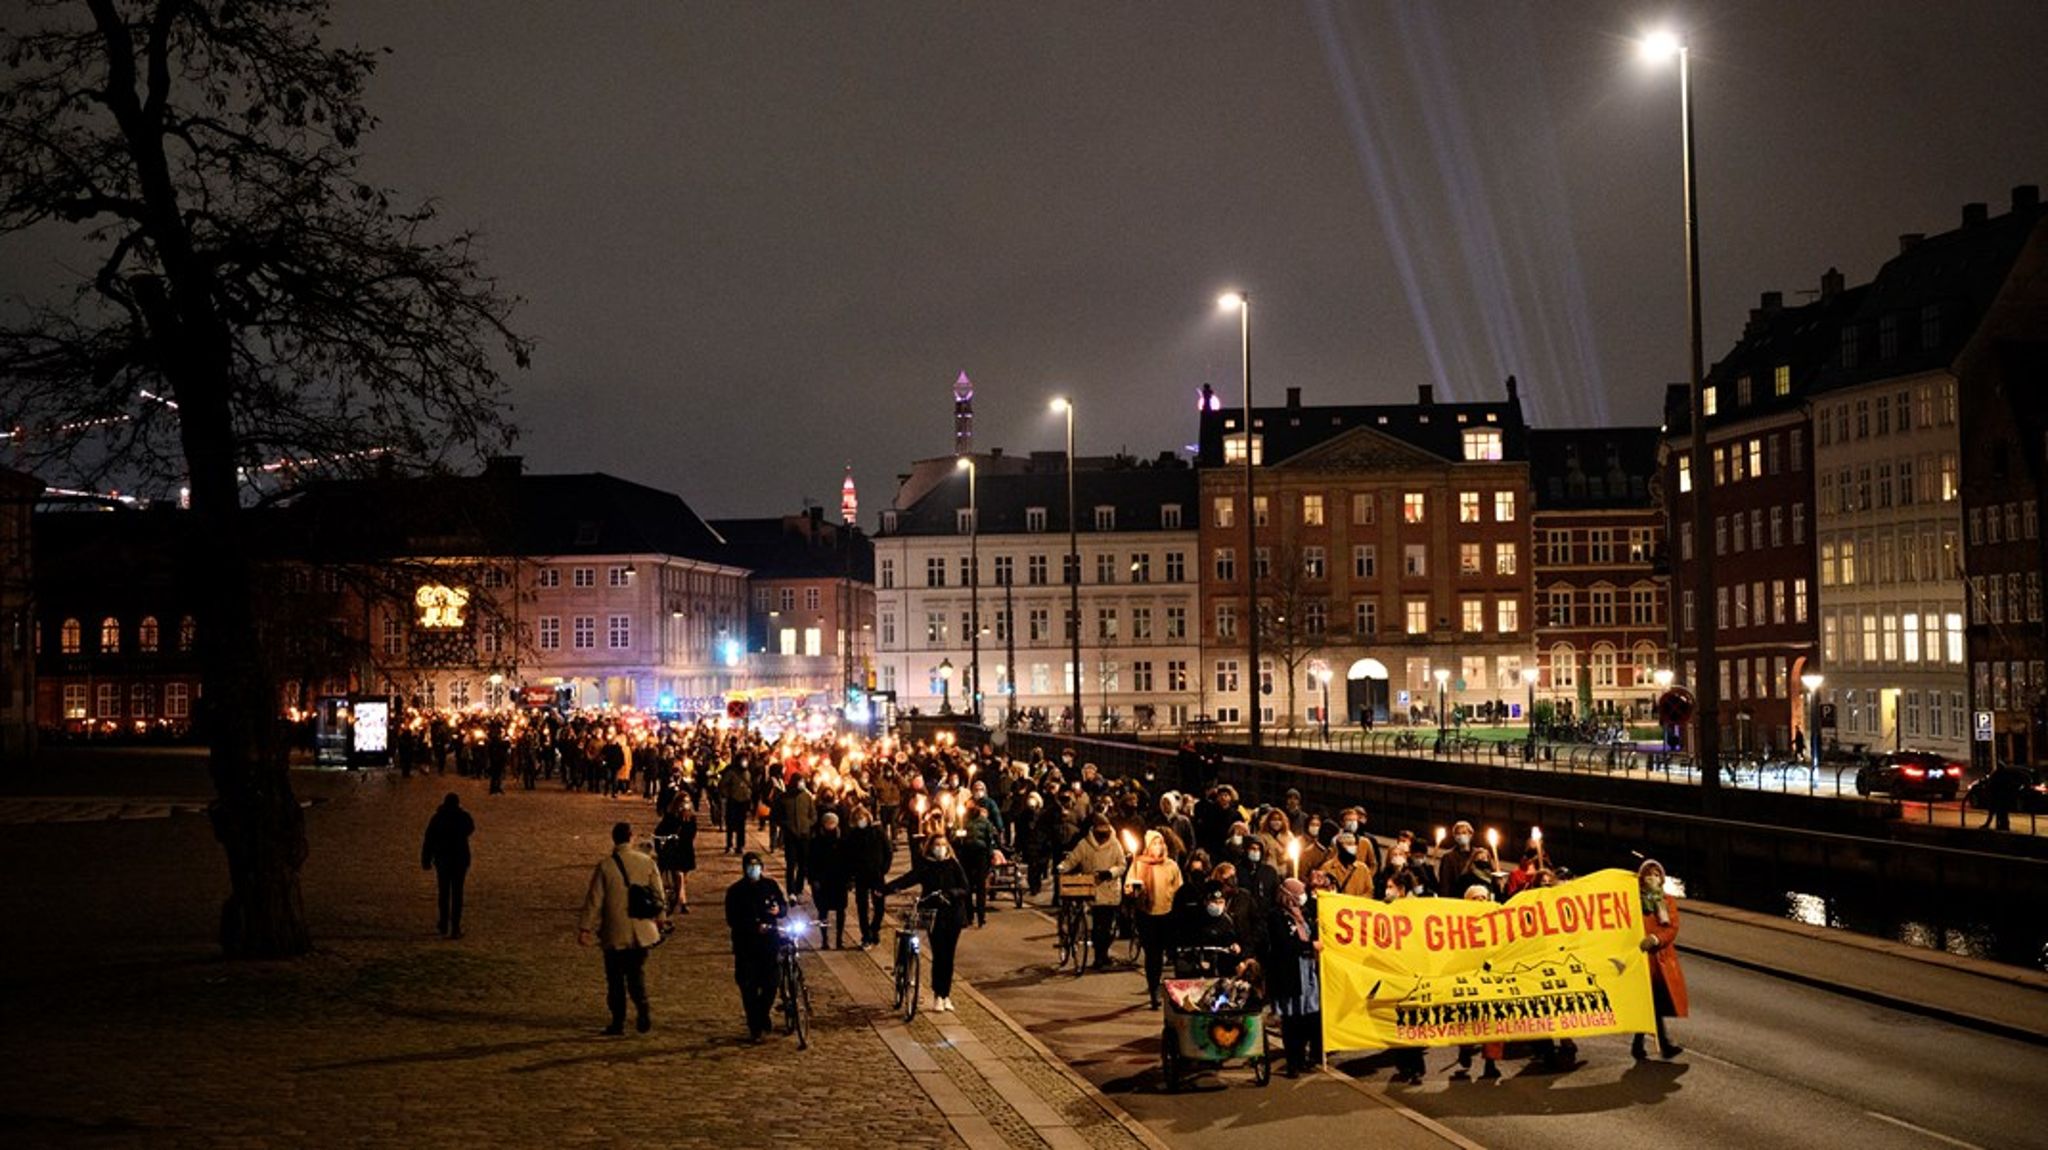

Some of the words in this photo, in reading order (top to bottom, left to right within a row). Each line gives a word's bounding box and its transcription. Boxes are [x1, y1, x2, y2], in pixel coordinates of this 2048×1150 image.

[1979, 713, 1990, 728] P
[1335, 908, 1413, 951] STOP
[1424, 891, 1632, 952] GHETTOLOVEN
[1397, 1021, 1467, 1040] FORSVAR
[1473, 1020, 1490, 1036] DE
[1496, 1016, 1556, 1034] ALMENE
[1561, 1011, 1616, 1030] BOLIGER
